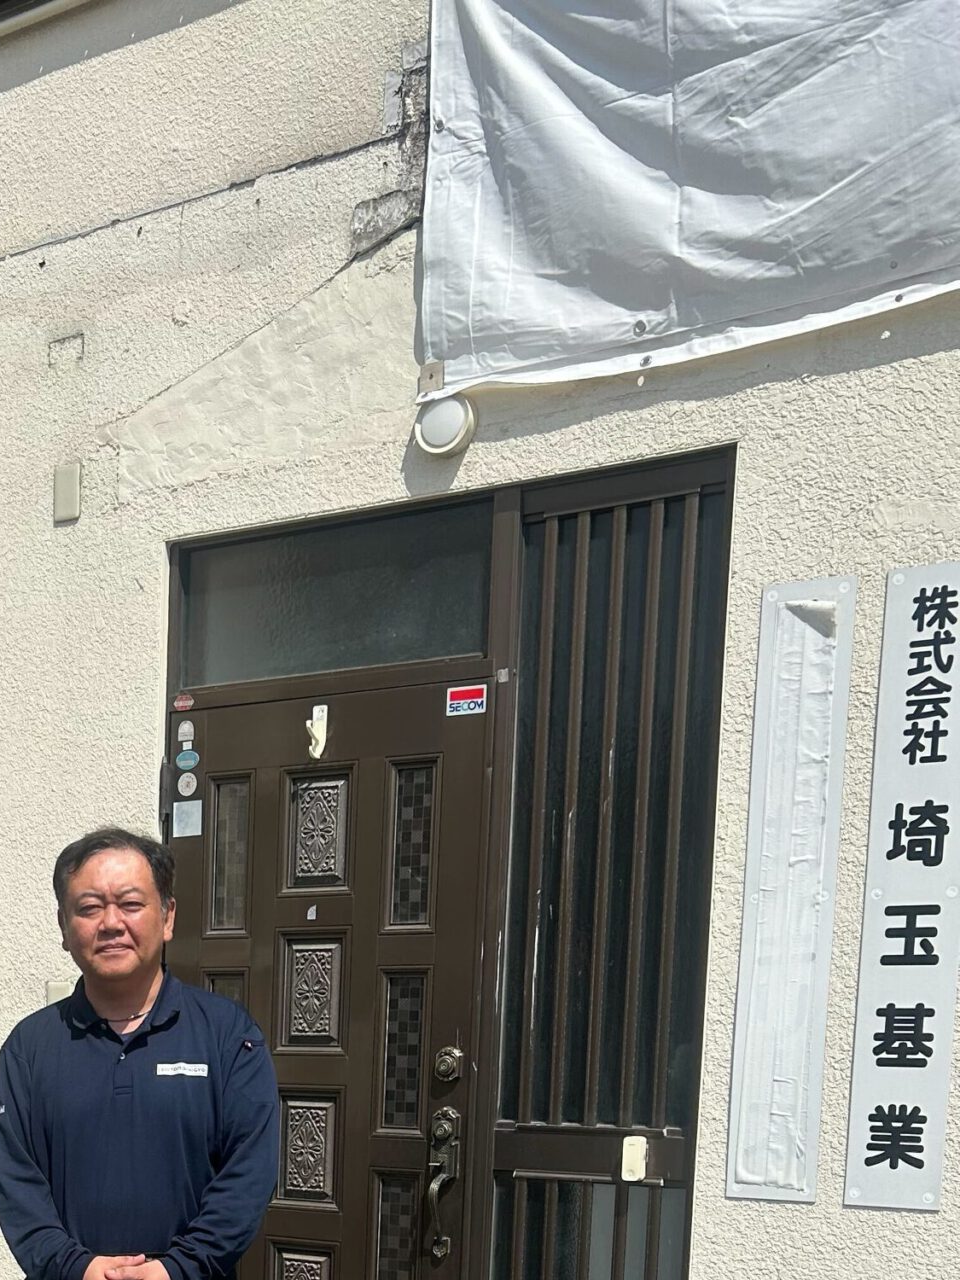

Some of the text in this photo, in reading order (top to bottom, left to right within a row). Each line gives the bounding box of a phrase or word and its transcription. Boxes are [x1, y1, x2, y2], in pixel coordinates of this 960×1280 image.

[449, 700, 484, 712] SECOM
[864, 585, 959, 1170] 株式会社 埼玉基業
